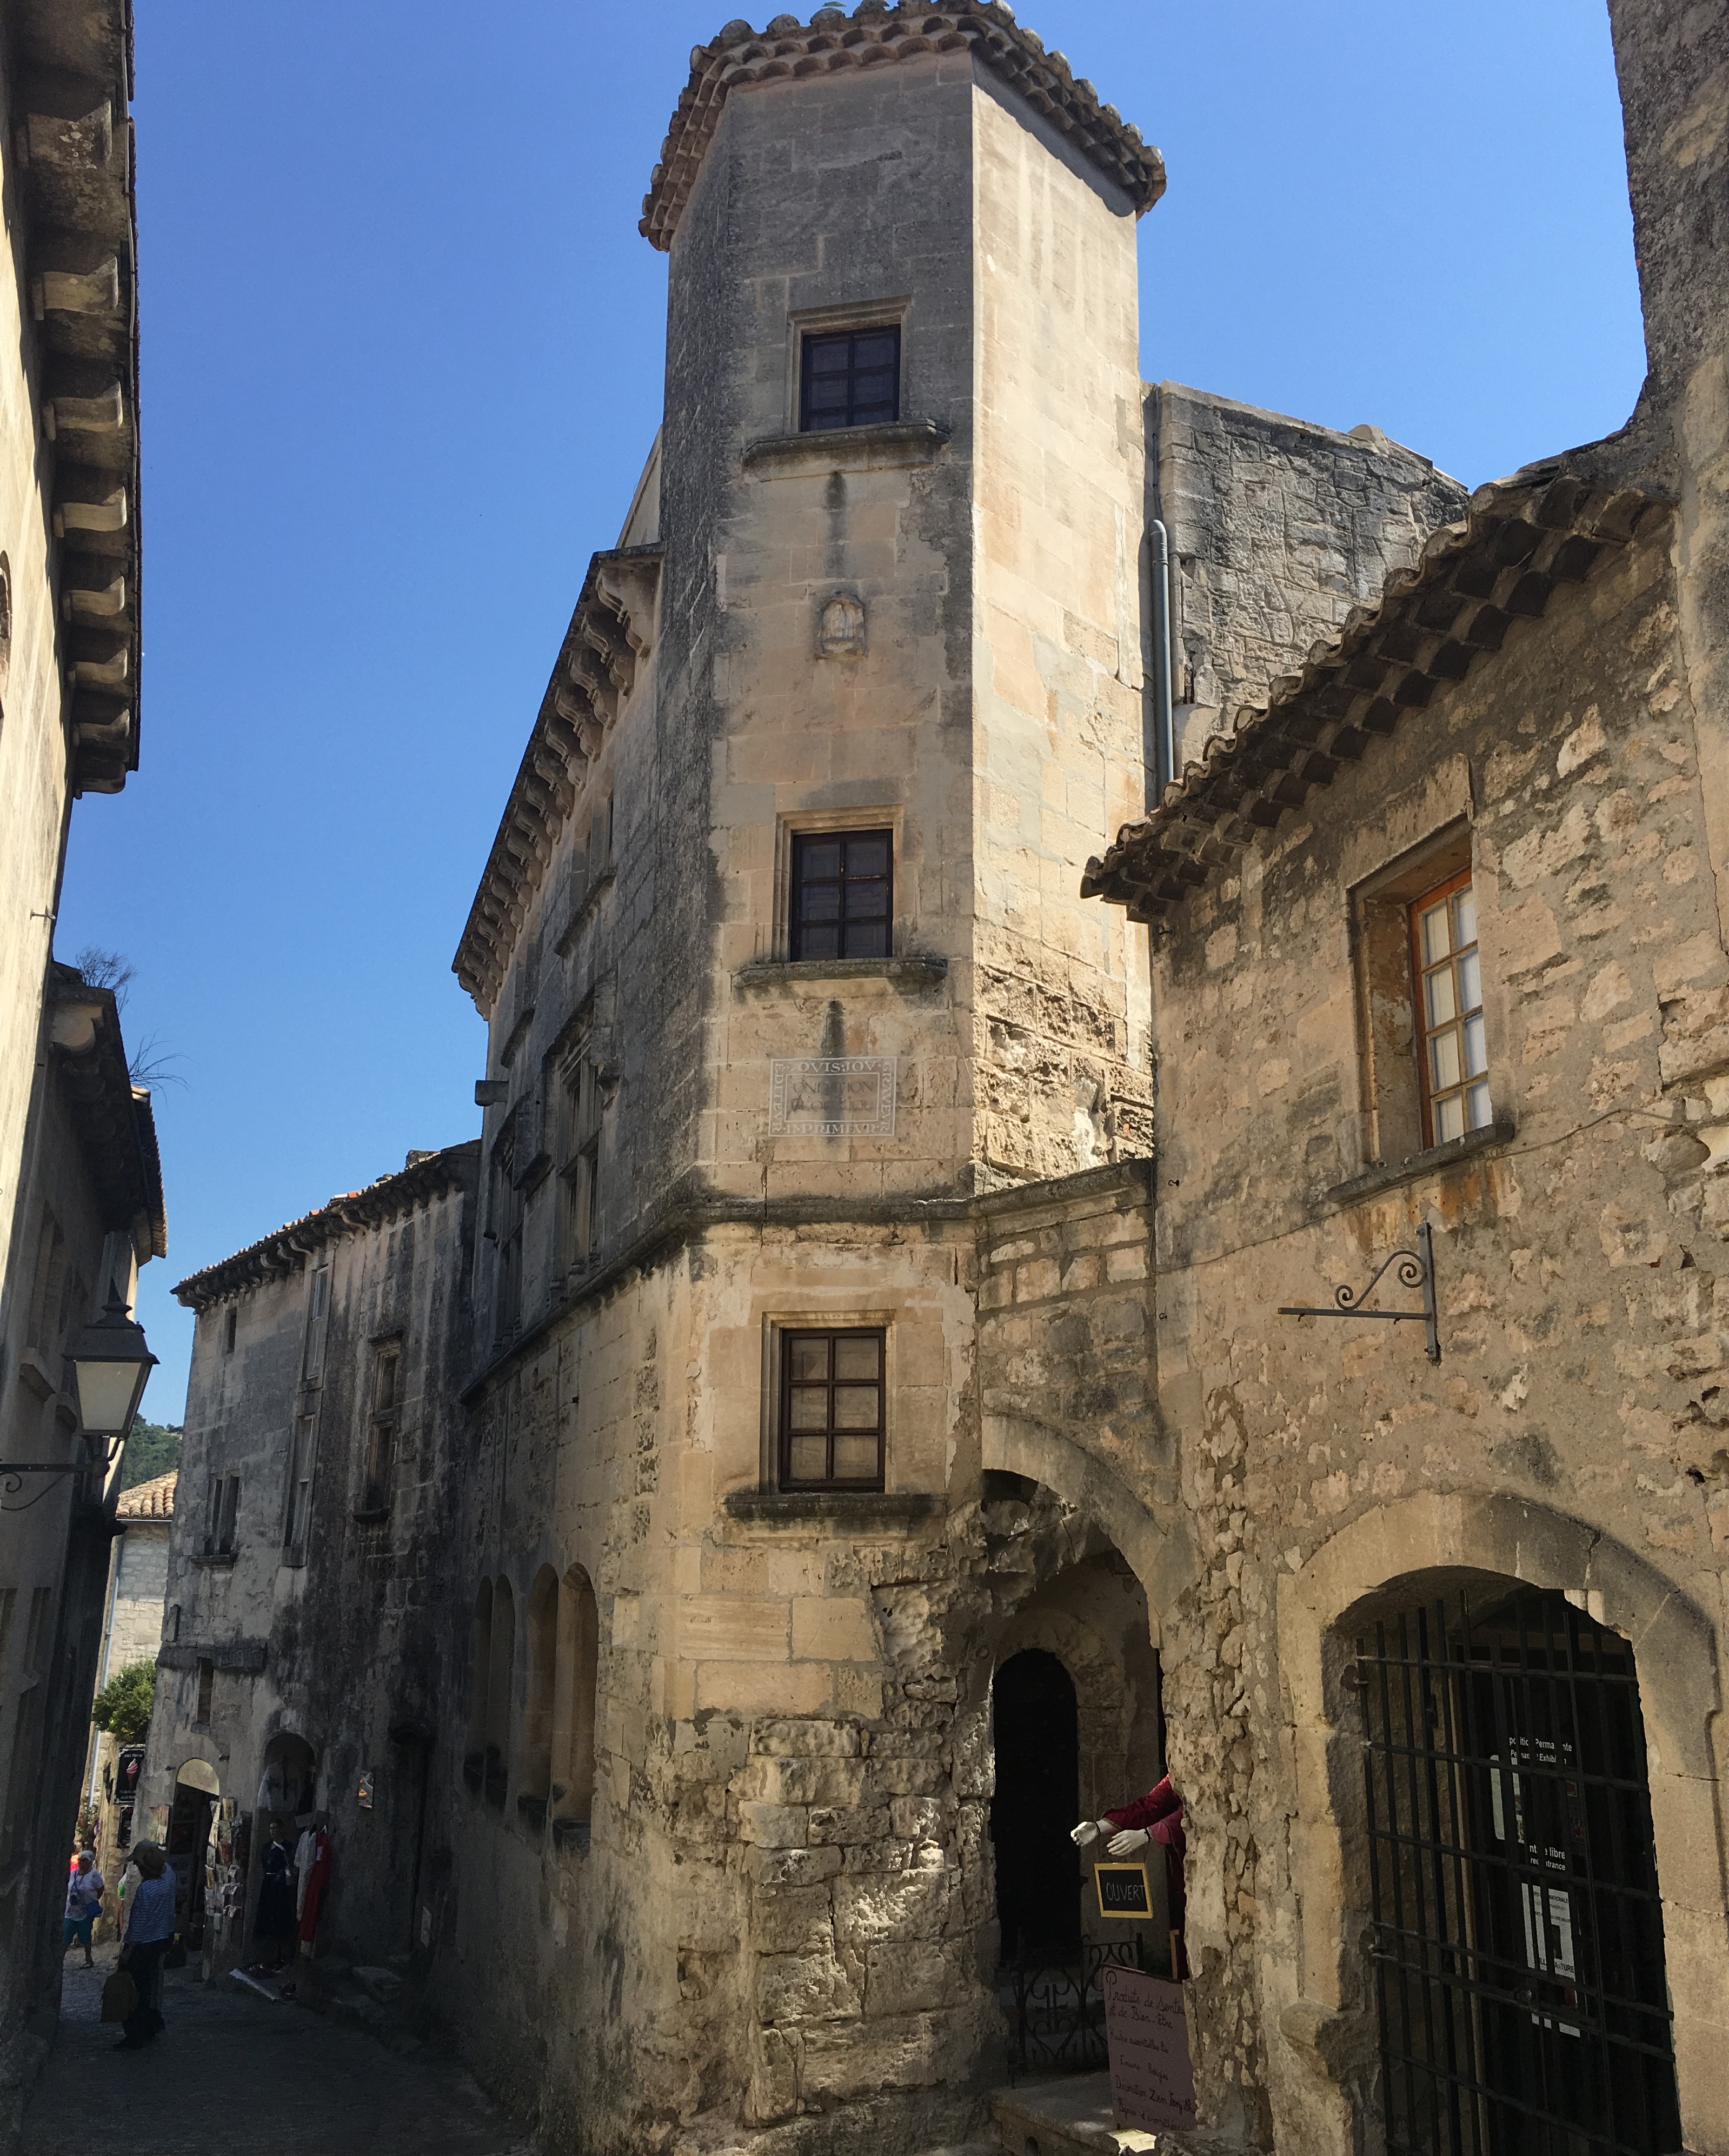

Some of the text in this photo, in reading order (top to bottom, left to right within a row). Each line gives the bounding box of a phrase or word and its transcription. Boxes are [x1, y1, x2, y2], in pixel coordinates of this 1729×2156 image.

[789, 1081, 873, 1094] FONDTION
[1549, 1847, 1566, 1860] libre
[1106, 1882, 1145, 1902] OUVERT
[1143, 1992, 1154, 2008] de
